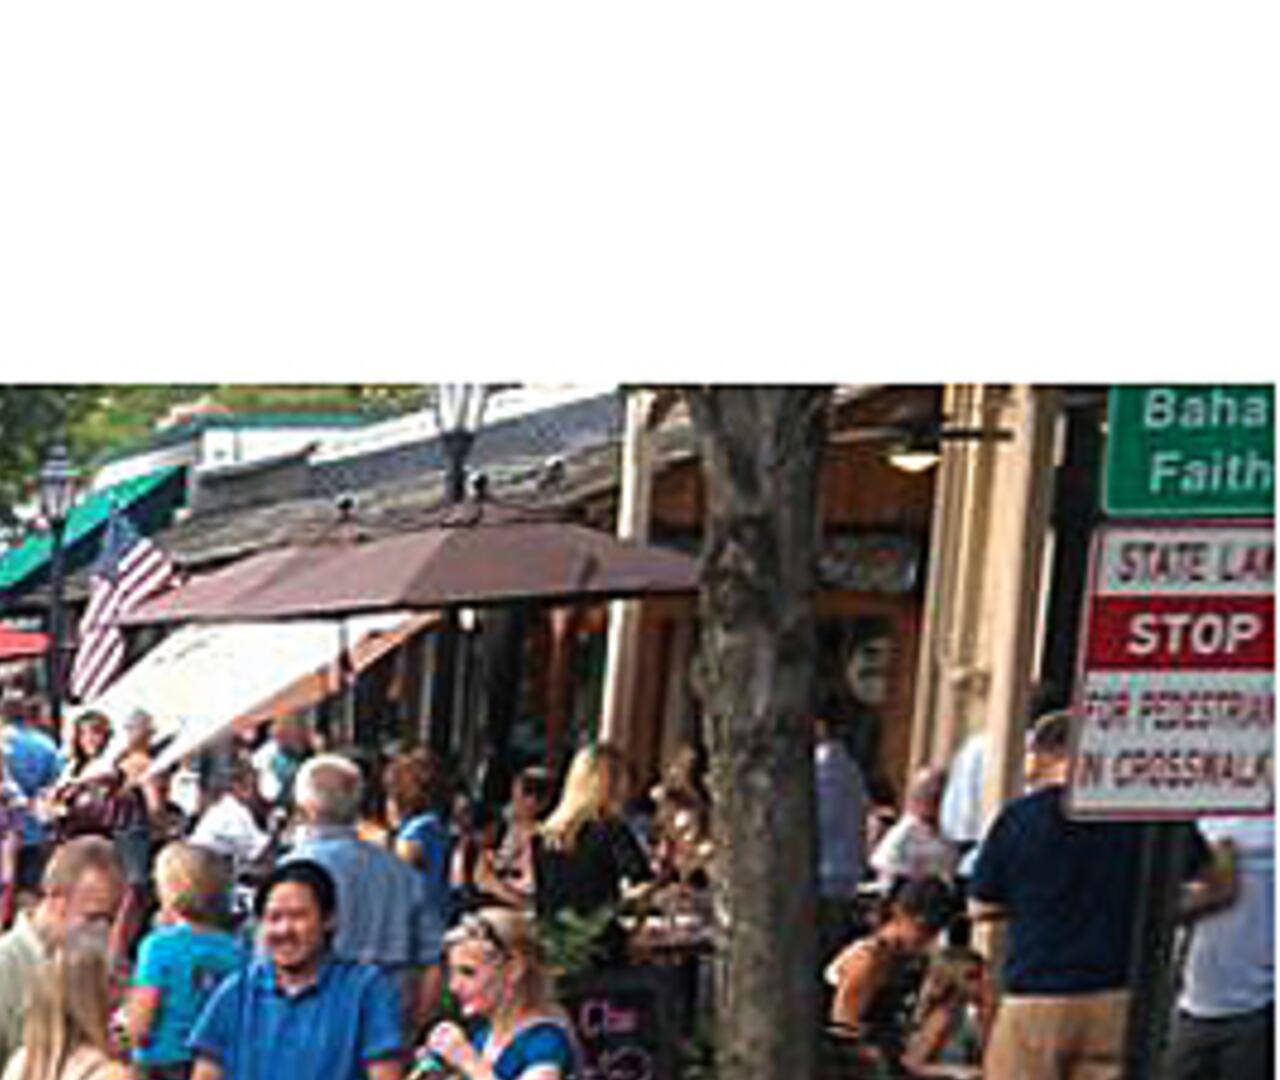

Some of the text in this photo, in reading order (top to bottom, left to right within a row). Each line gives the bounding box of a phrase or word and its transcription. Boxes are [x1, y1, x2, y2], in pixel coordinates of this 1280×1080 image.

[1150, 448, 1274, 492] Faith
[1117, 541, 1209, 582] STATE
[1127, 611, 1261, 658] STOP
